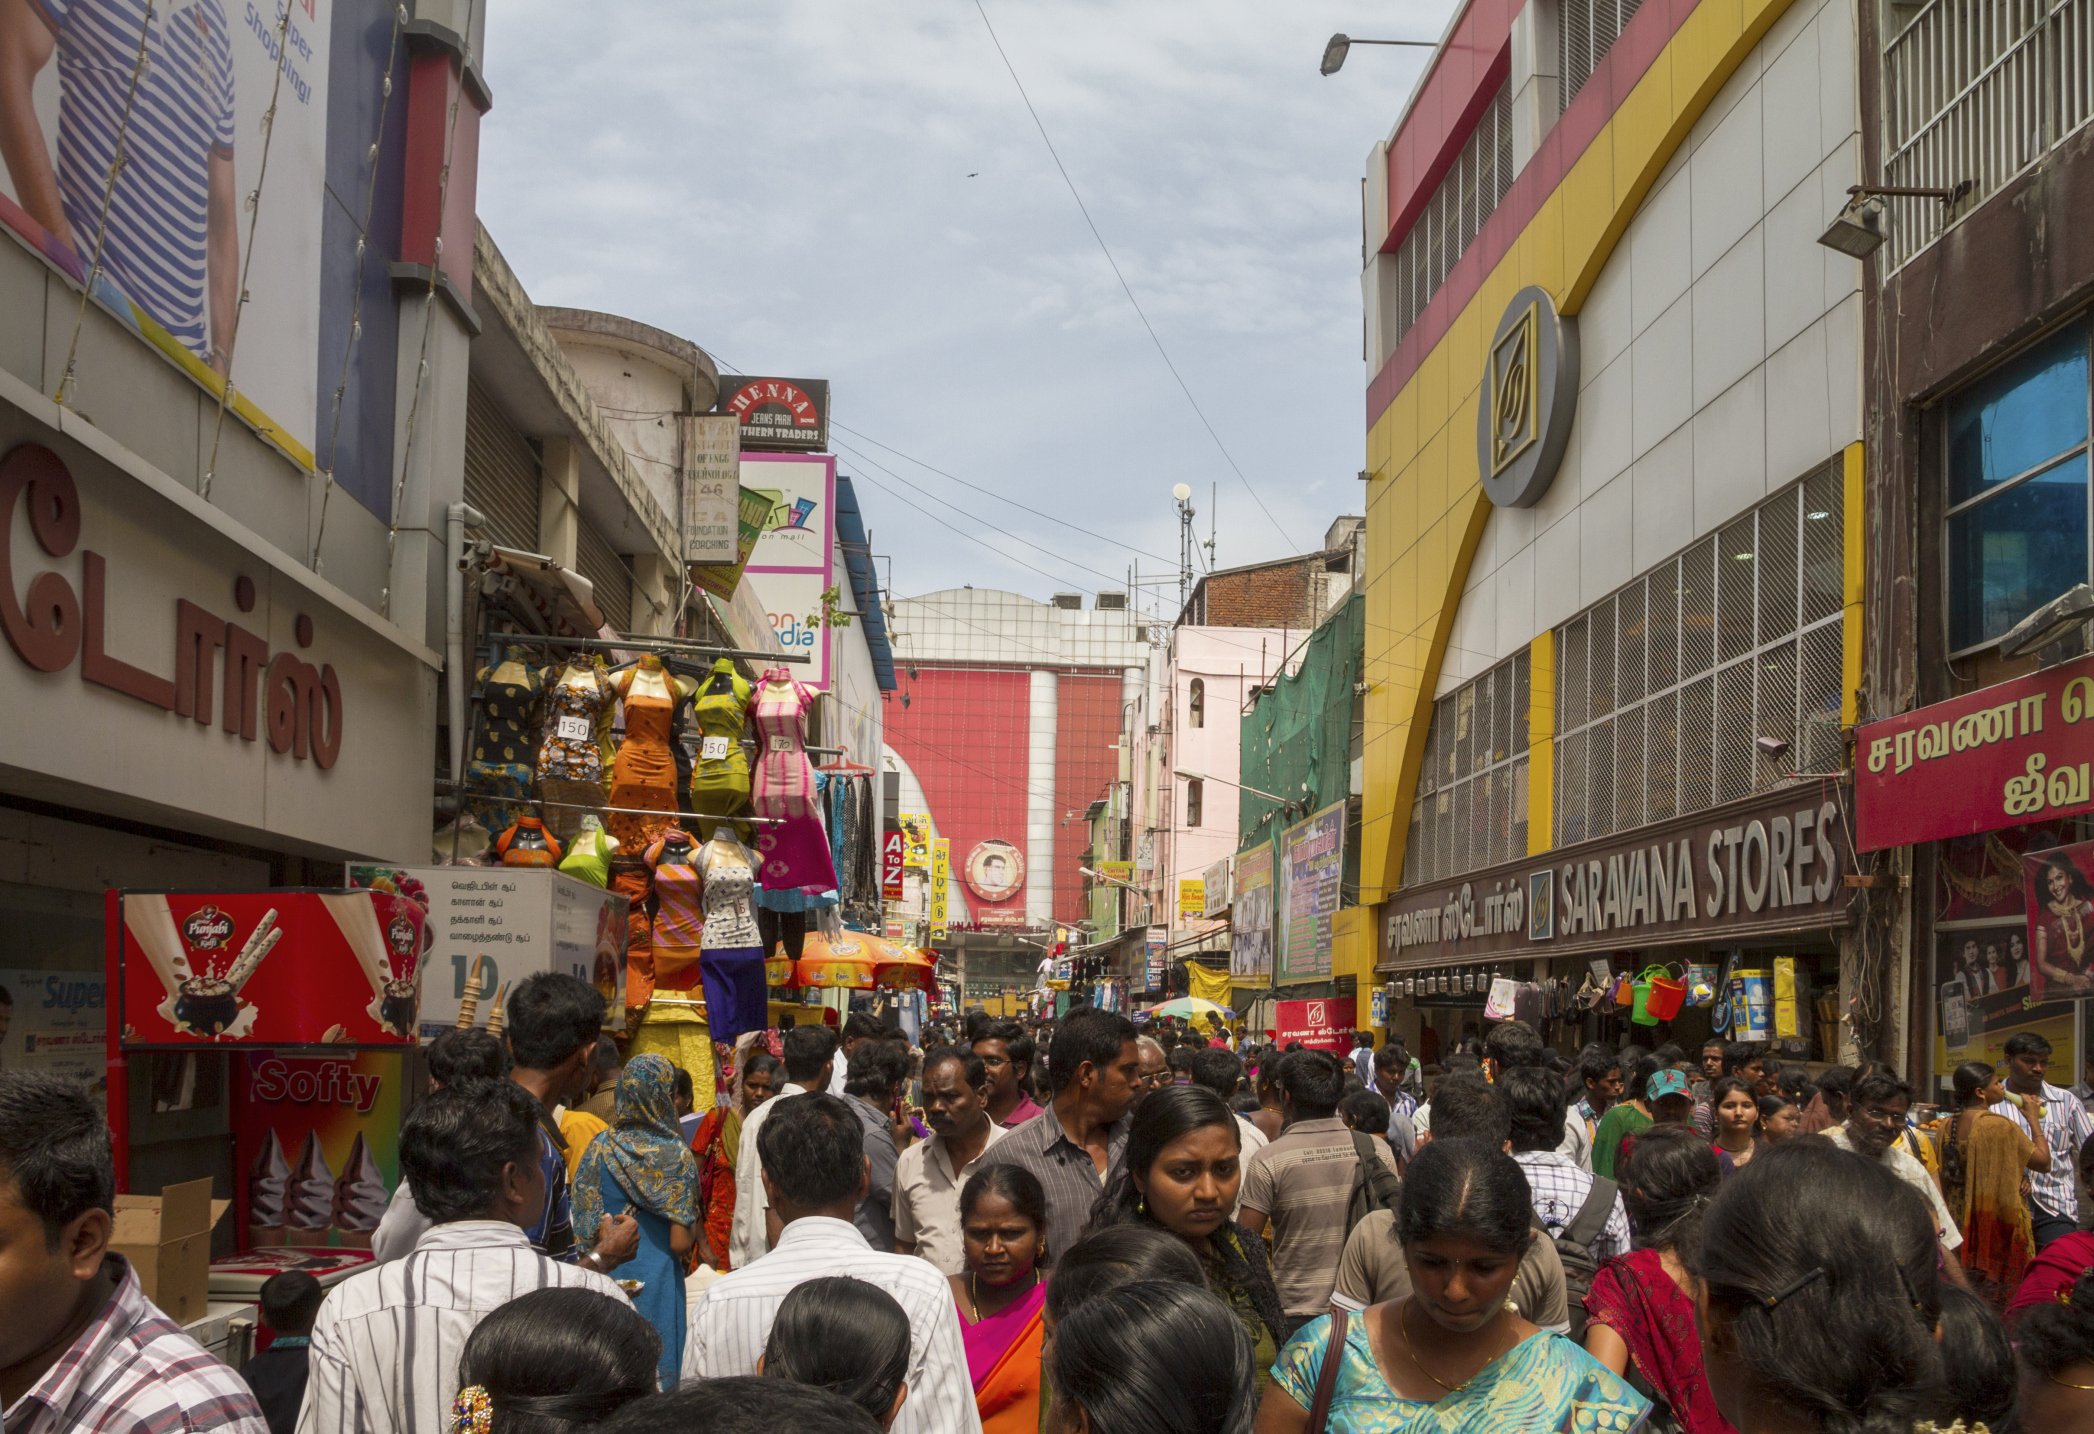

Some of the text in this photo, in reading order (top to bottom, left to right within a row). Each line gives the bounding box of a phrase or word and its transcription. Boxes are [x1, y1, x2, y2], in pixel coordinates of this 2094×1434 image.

[244, 1, 312, 106] Shopping!
[729, 383, 816, 424] HENNAI
[751, 412, 773, 425] JEANS
[775, 428, 819, 441] TRADERS
[697, 453, 709, 464] OF
[686, 524, 730, 536] FOUNDATION
[560, 721, 588, 736] 150
[1867, 692, 2048, 775] சரவணா
[703, 741, 727, 755] 150
[773, 737, 790, 750] 170
[2003, 752, 2093, 816] ஜீவ
[884, 834, 902, 853] A
[887, 854, 900, 864] To
[883, 866, 902, 884] Z
[1560, 801, 1838, 936] SARAVANA STORES
[501, 882, 516, 893] சூப்
[451, 898, 504, 908] காளான் சூப்
[450, 914, 503, 926] தக்காளி சூப்
[1387, 907, 1442, 957] சரவணா
[1442, 878, 1524, 941] ஸ்டோர்ஸ்
[188, 921, 230, 939] Punjabi
[516, 933, 531, 943] சூப்
[1282, 1029, 1315, 1038] சரவணா
[256, 1059, 381, 1113] Softy
